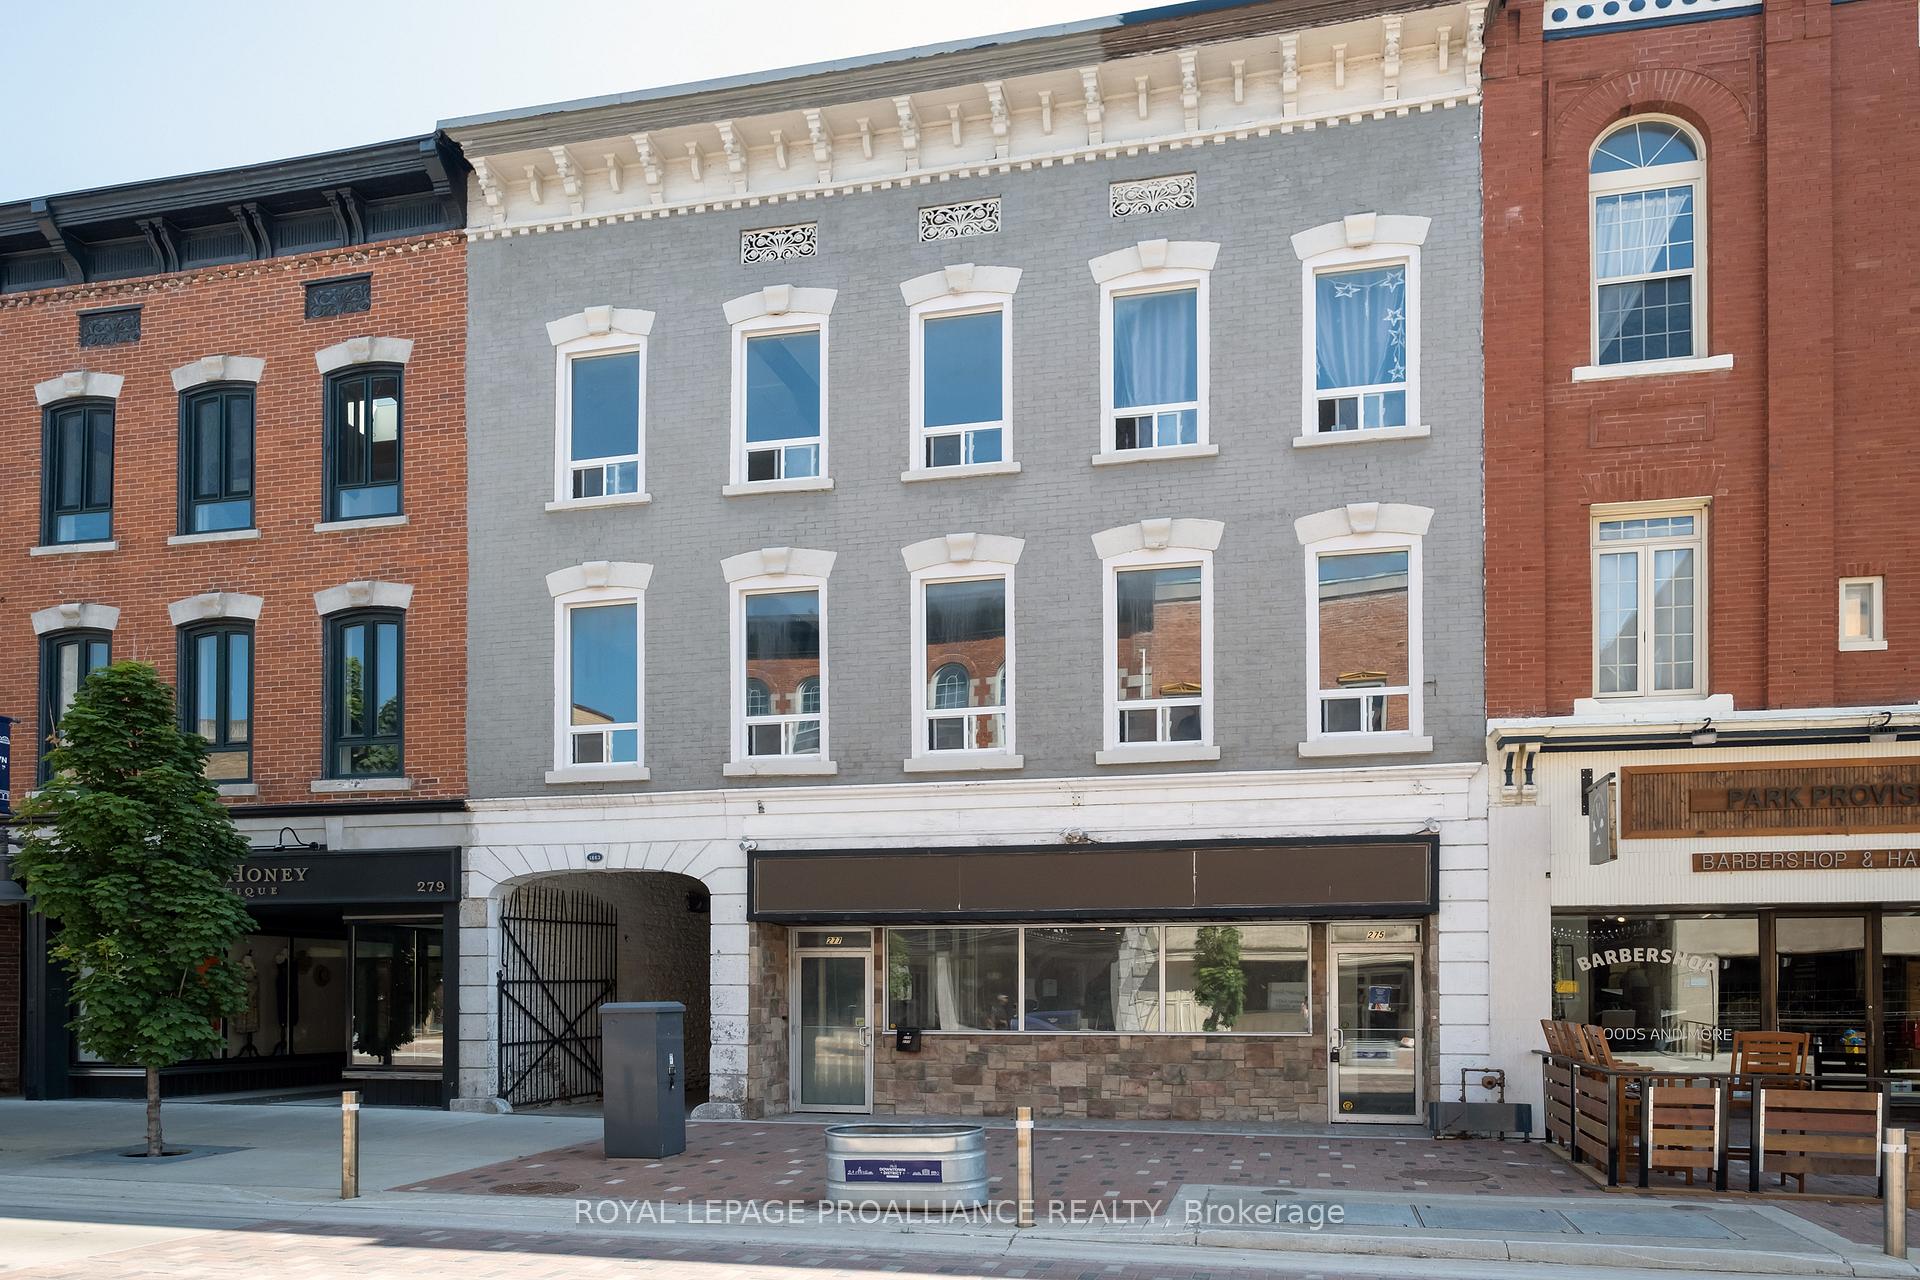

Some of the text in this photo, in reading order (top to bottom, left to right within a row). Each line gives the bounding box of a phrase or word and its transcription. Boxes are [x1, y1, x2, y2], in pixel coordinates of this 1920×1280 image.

[1727, 785, 1803, 810] PARK
[1702, 850, 1917, 870] BARBERSHOP & HA
[417, 881, 445, 892] 279
[826, 936, 843, 945] 277
[1367, 931, 1385, 939] 275
[1576, 947, 1717, 973] BARBERSHOP
[1603, 1027, 1733, 1041] OODS AND MORE
